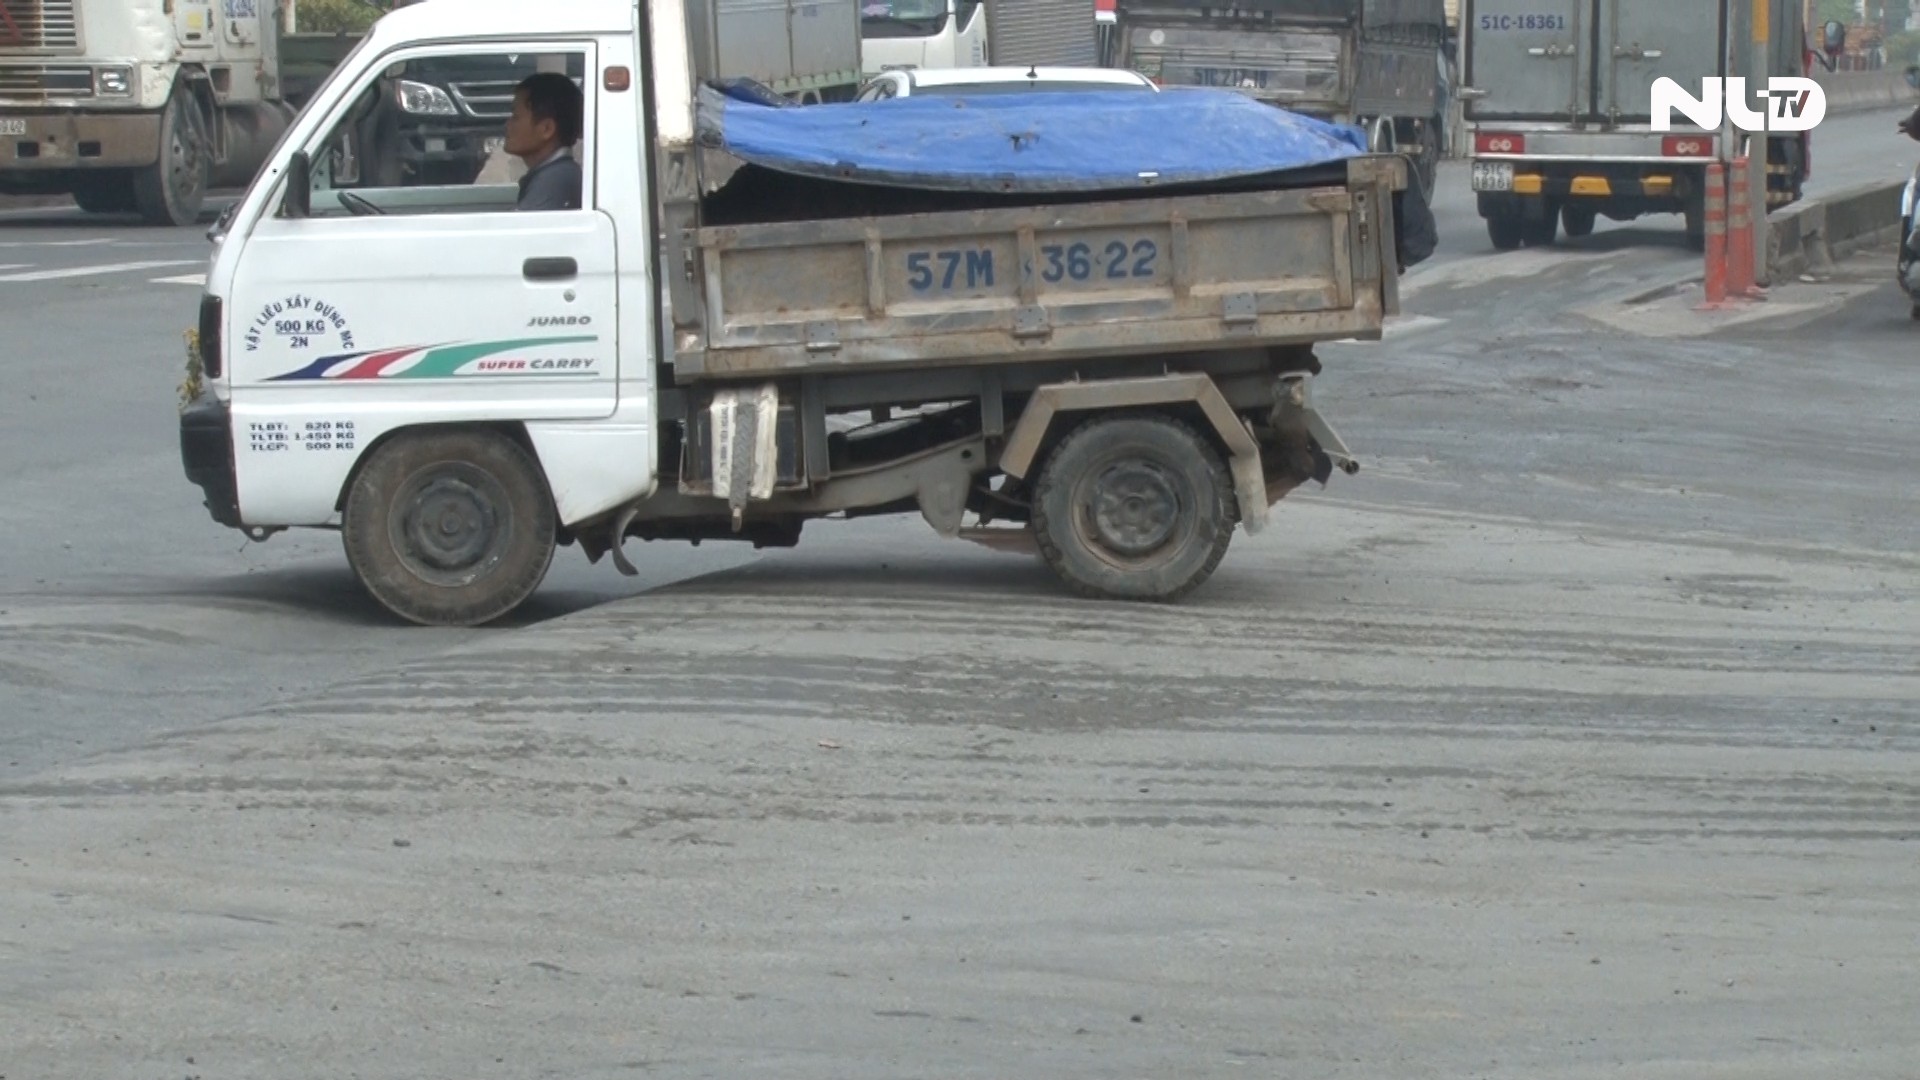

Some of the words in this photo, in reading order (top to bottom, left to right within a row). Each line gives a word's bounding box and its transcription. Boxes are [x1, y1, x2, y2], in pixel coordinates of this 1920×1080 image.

[1481, 14, 1564, 31] 51C-18361
[907, 250, 994, 290] 57M
[275, 320, 301, 332] 500
[306, 320, 325, 332] KG
[527, 315, 592, 327] JUMBO
[290, 336, 308, 348] 2N
[478, 360, 526, 370] SUPER
[529, 359, 595, 369] CARRY
